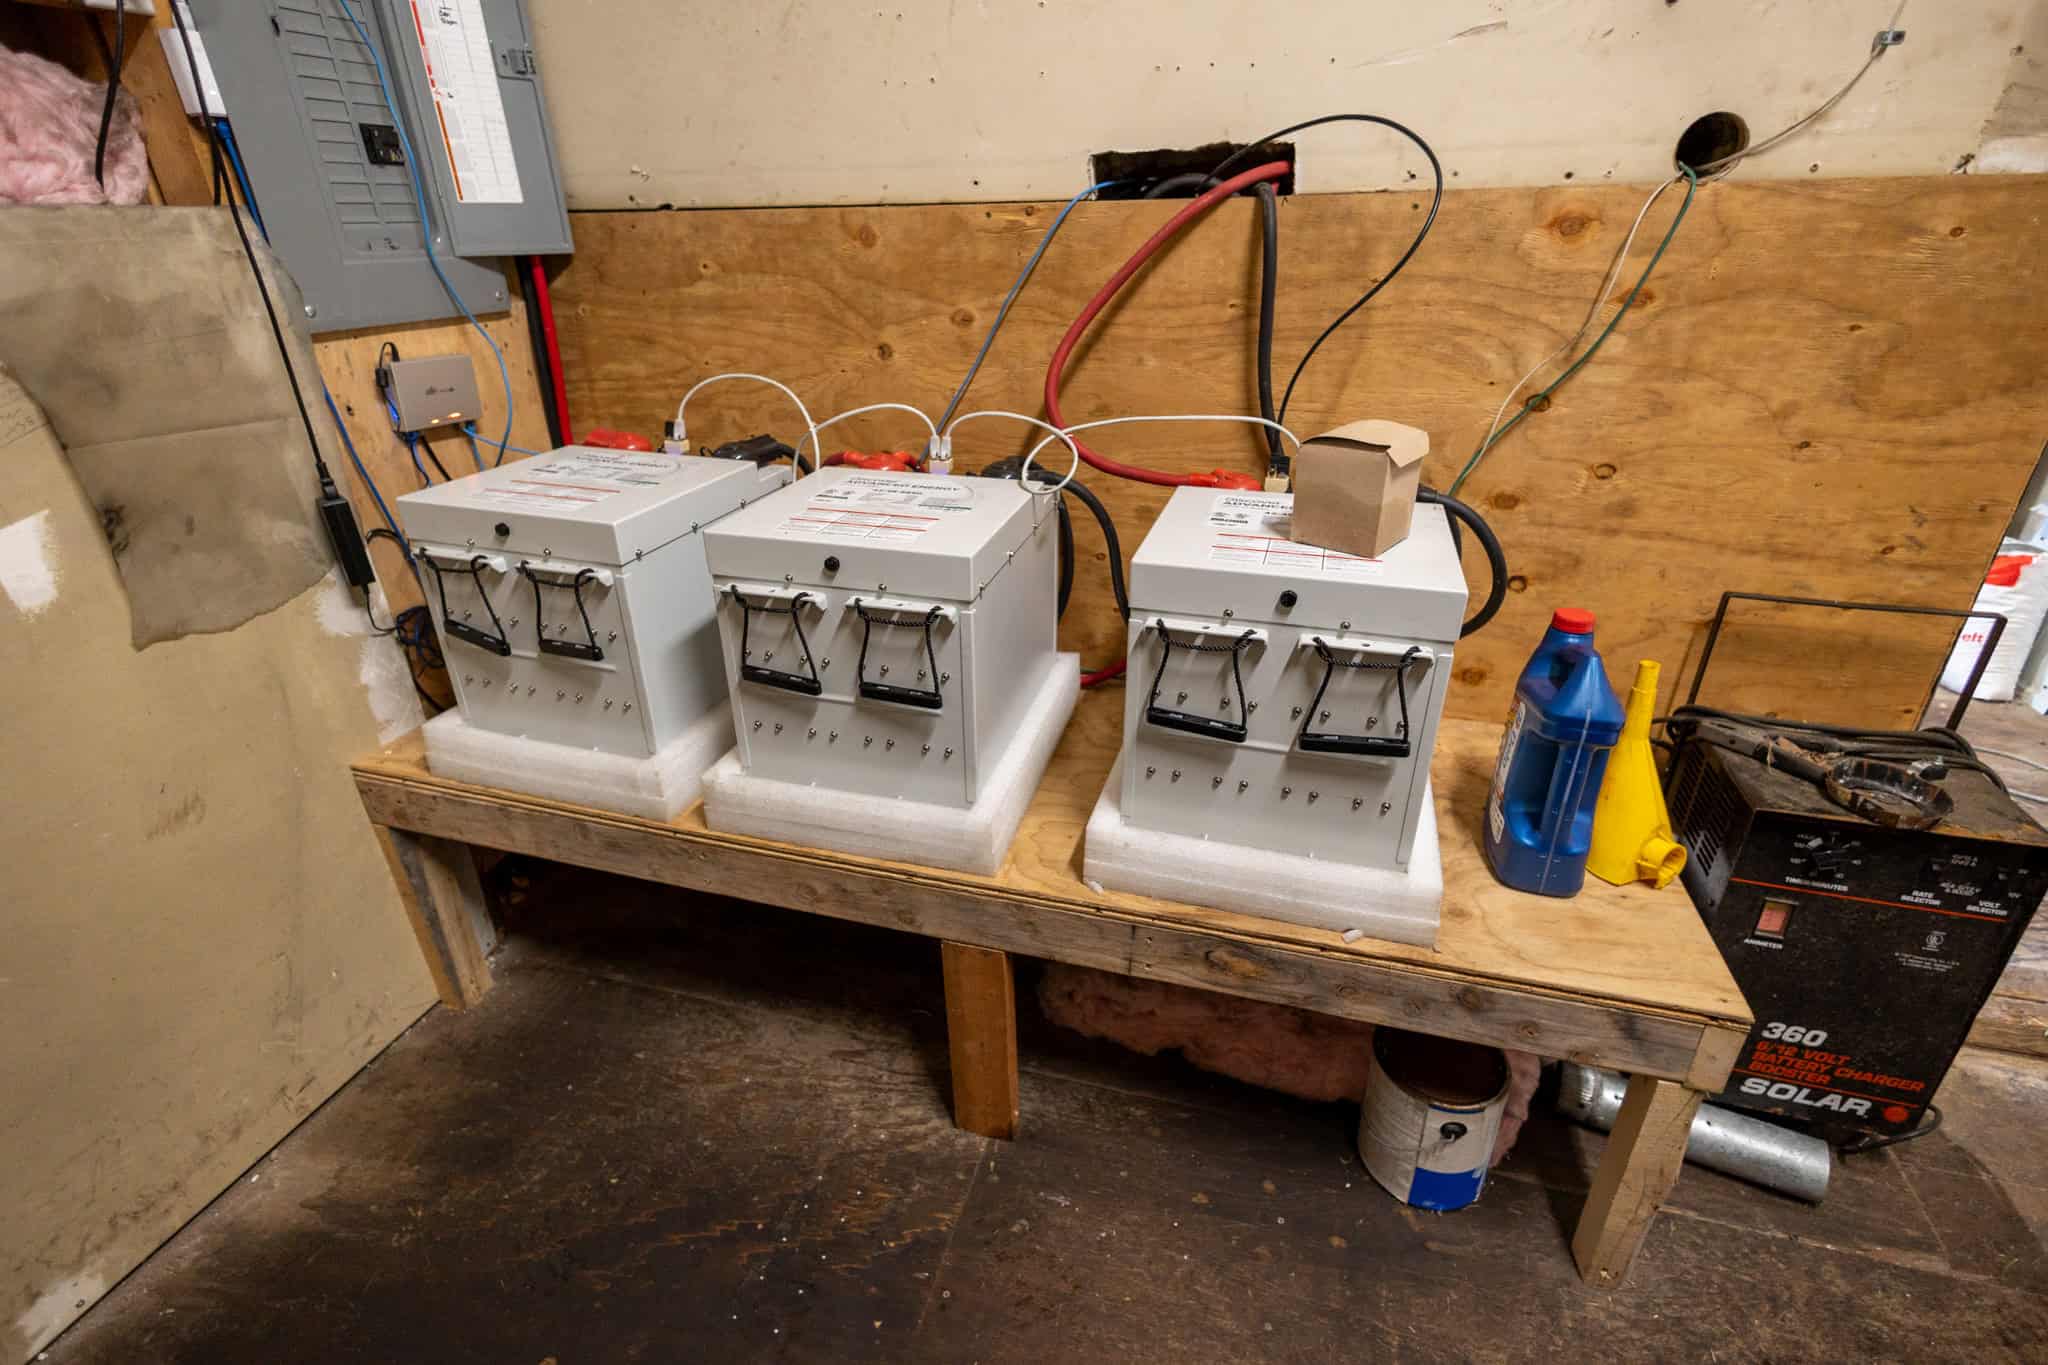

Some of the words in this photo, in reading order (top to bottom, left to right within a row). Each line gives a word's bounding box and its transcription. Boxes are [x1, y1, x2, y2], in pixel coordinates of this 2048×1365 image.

[1962, 632, 1985, 643] elt
[1762, 1022, 1828, 1047] 360
[1755, 1040, 1800, 1058] 6/12
[1804, 1050, 1851, 1065] VOLT
[1747, 1061, 1832, 1085] BOOSTER
[1751, 1050, 1834, 1074] BATTERY
[1835, 1067, 1925, 1091] CHARGER
[1740, 1077, 1872, 1115] SOLAR
